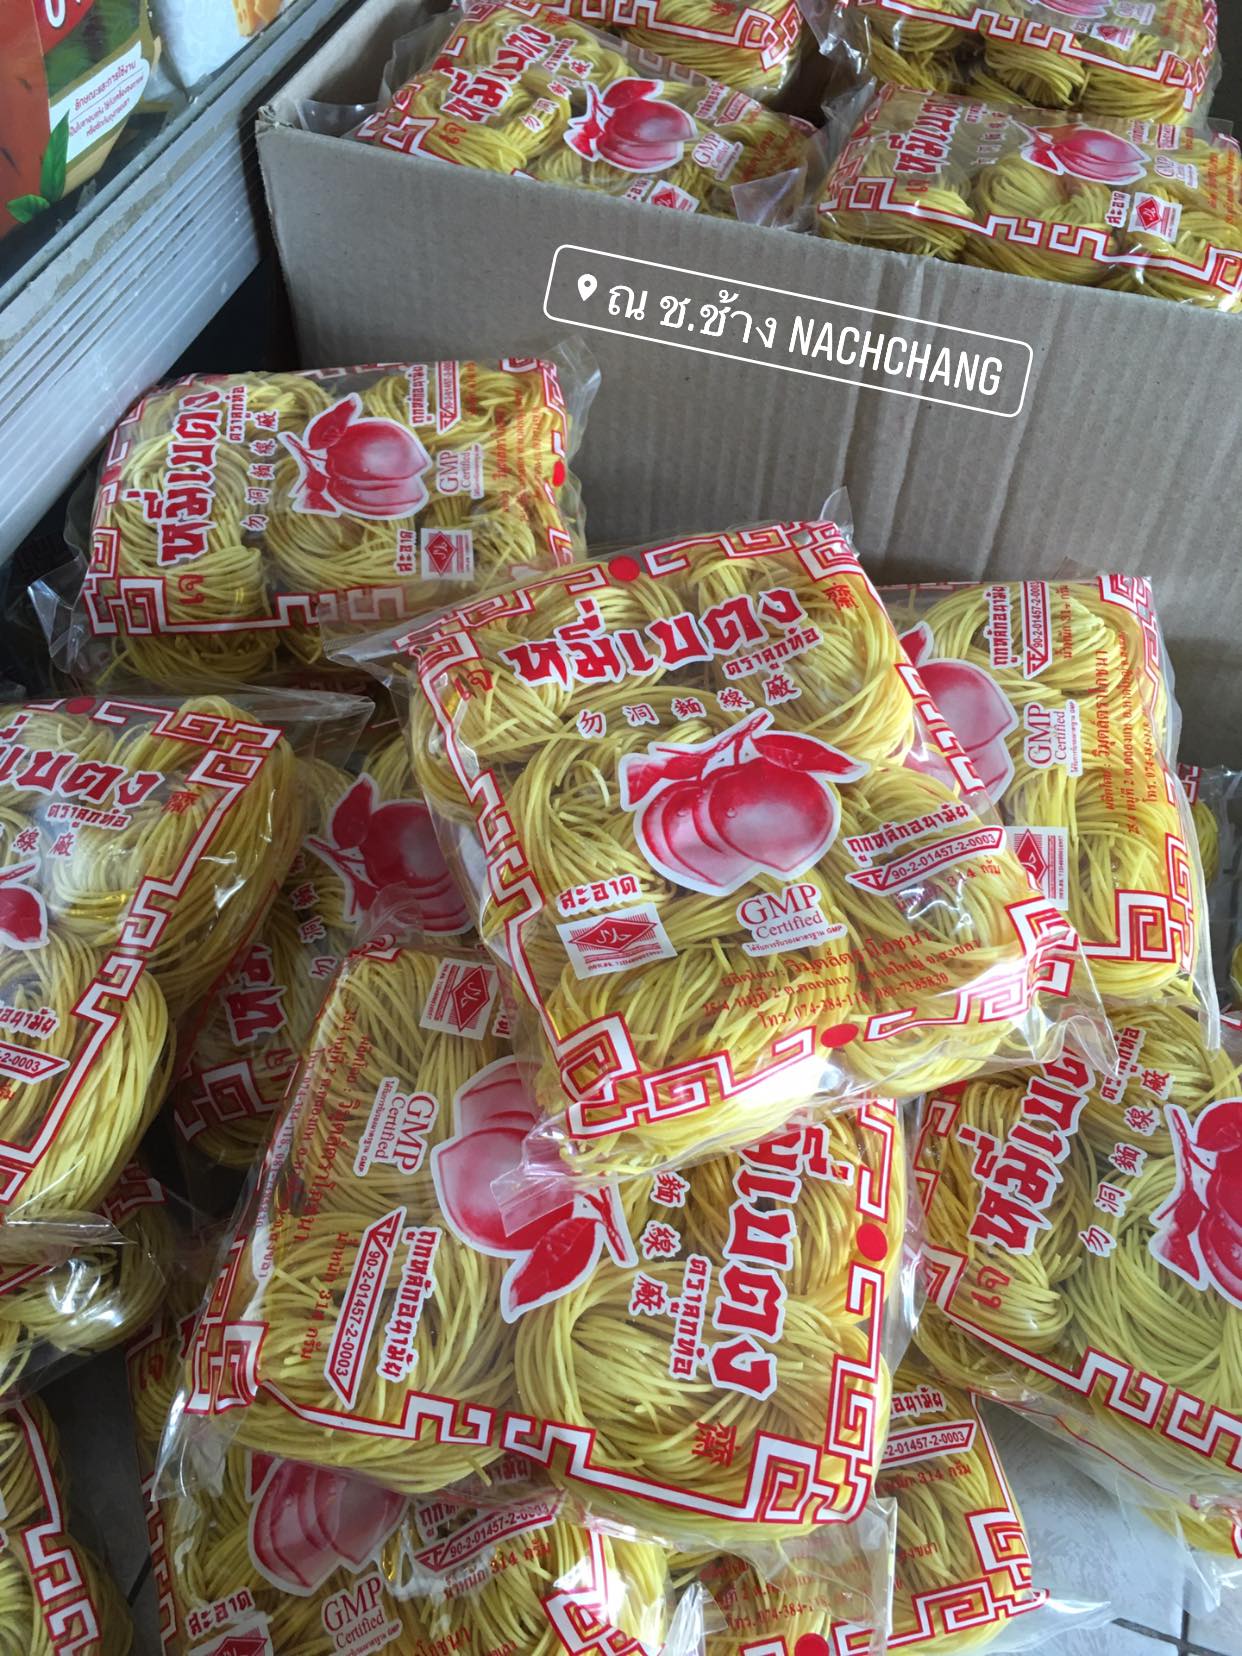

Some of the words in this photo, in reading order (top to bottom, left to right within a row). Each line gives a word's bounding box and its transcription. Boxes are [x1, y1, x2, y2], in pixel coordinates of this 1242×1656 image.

[440, 451, 458, 493] GMP
[502, 588, 803, 686] หมี่เบตง
[726, 624, 819, 677] ตราลูกท้อ
[1028, 704, 1051, 763] GMP
[1054, 710, 1067, 760] Certified
[848, 804, 967, 862] ถูกหลักอนามัย
[892, 832, 997, 881] 90-2-01457-2-0003
[560, 876, 637, 910] สะอาด
[741, 885, 818, 926] GMP
[756, 911, 824, 940] Certified
[826, 925, 842, 934] GMP
[372, 1096, 404, 1161] Certified
[399, 1093, 435, 1170] GMP
[356, 1154, 368, 1172] GMP
[711, 1126, 849, 1393] มี่เบตง
[334, 1251, 381, 1376] 90-2-01457-2-0003
[381, 1230, 436, 1376] ถูกหลักอนามัย
[673, 1258, 707, 1375] ตราลูกท้อ
[491, 1551, 519, 1574] 314
[189, 1590, 252, 1637] สะอาด
[324, 1577, 382, 1632] GMP
[336, 1611, 385, 1649] Certified
